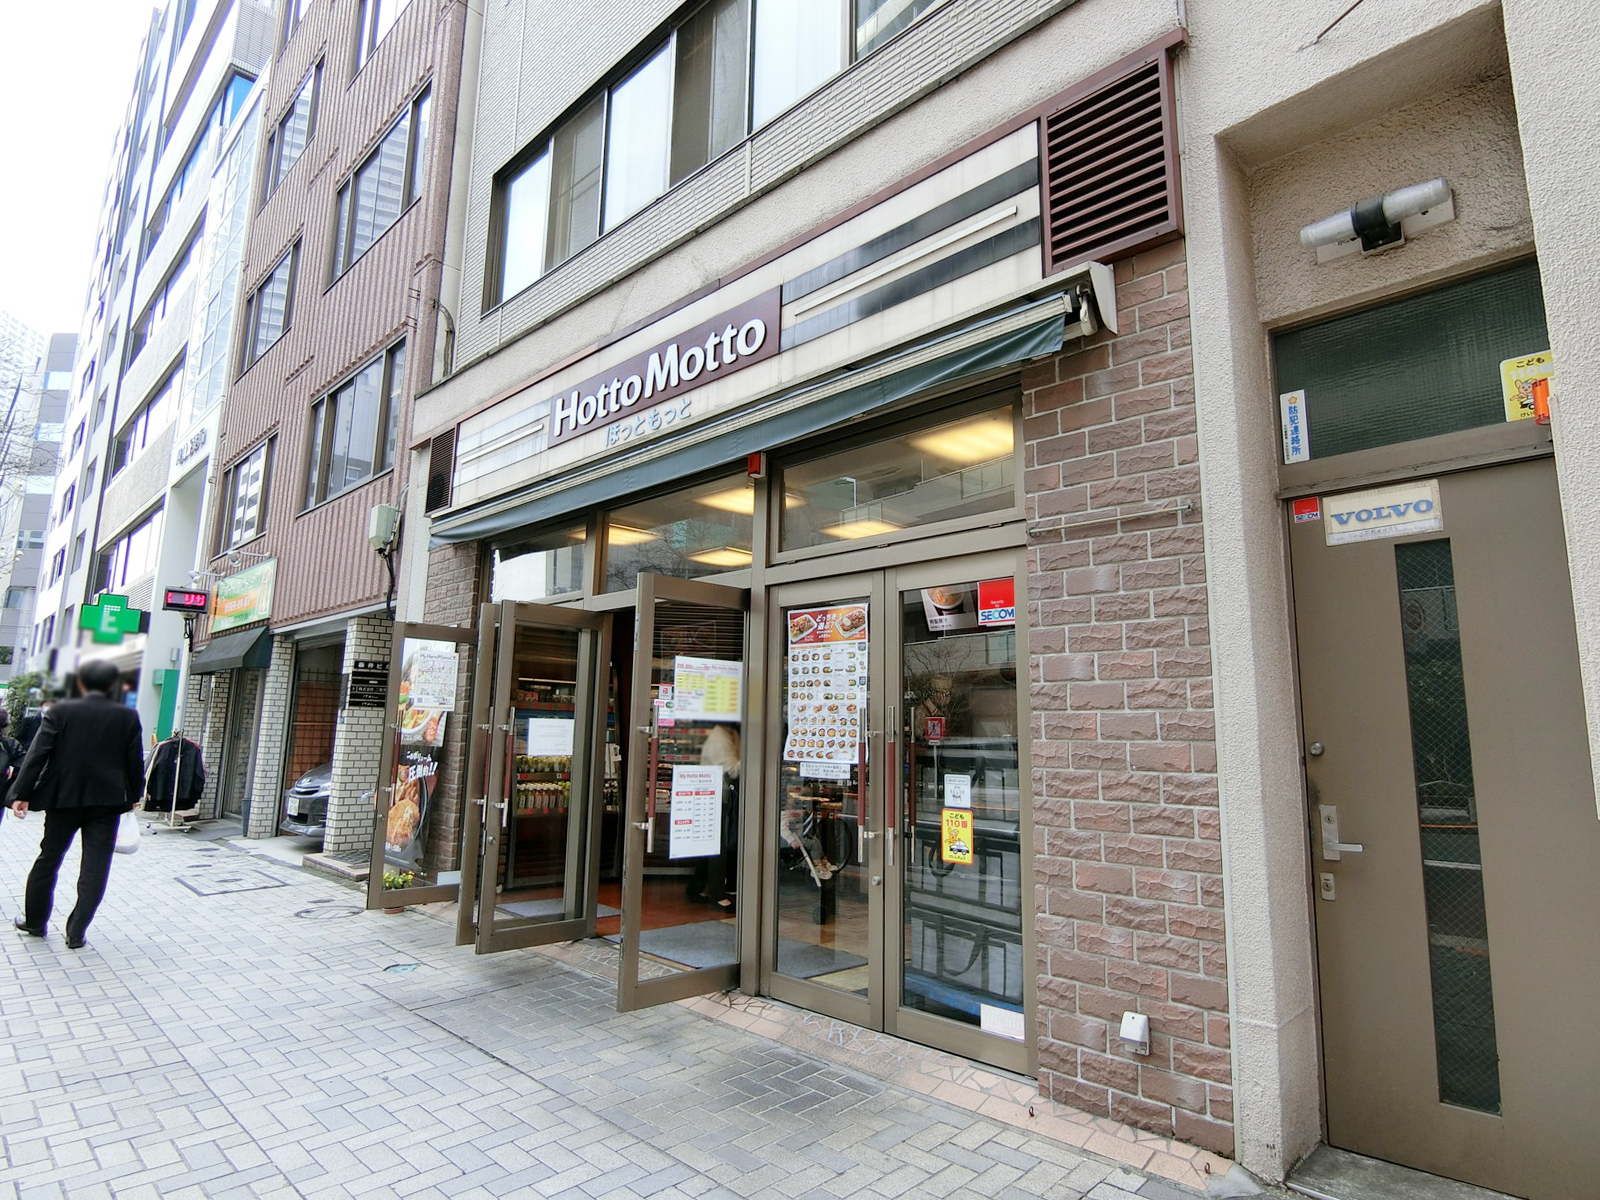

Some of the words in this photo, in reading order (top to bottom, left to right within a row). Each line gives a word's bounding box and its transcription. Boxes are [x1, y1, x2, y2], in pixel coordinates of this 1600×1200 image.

[1516, 357, 1546, 368] こども
[606, 398, 692, 446] ほっともっと
[1288, 405, 1301, 456] 防犯連絡所
[1295, 512, 1319, 521] SECOM
[1331, 499, 1434, 525] VOLVO
[980, 608, 1015, 621] SECOM
